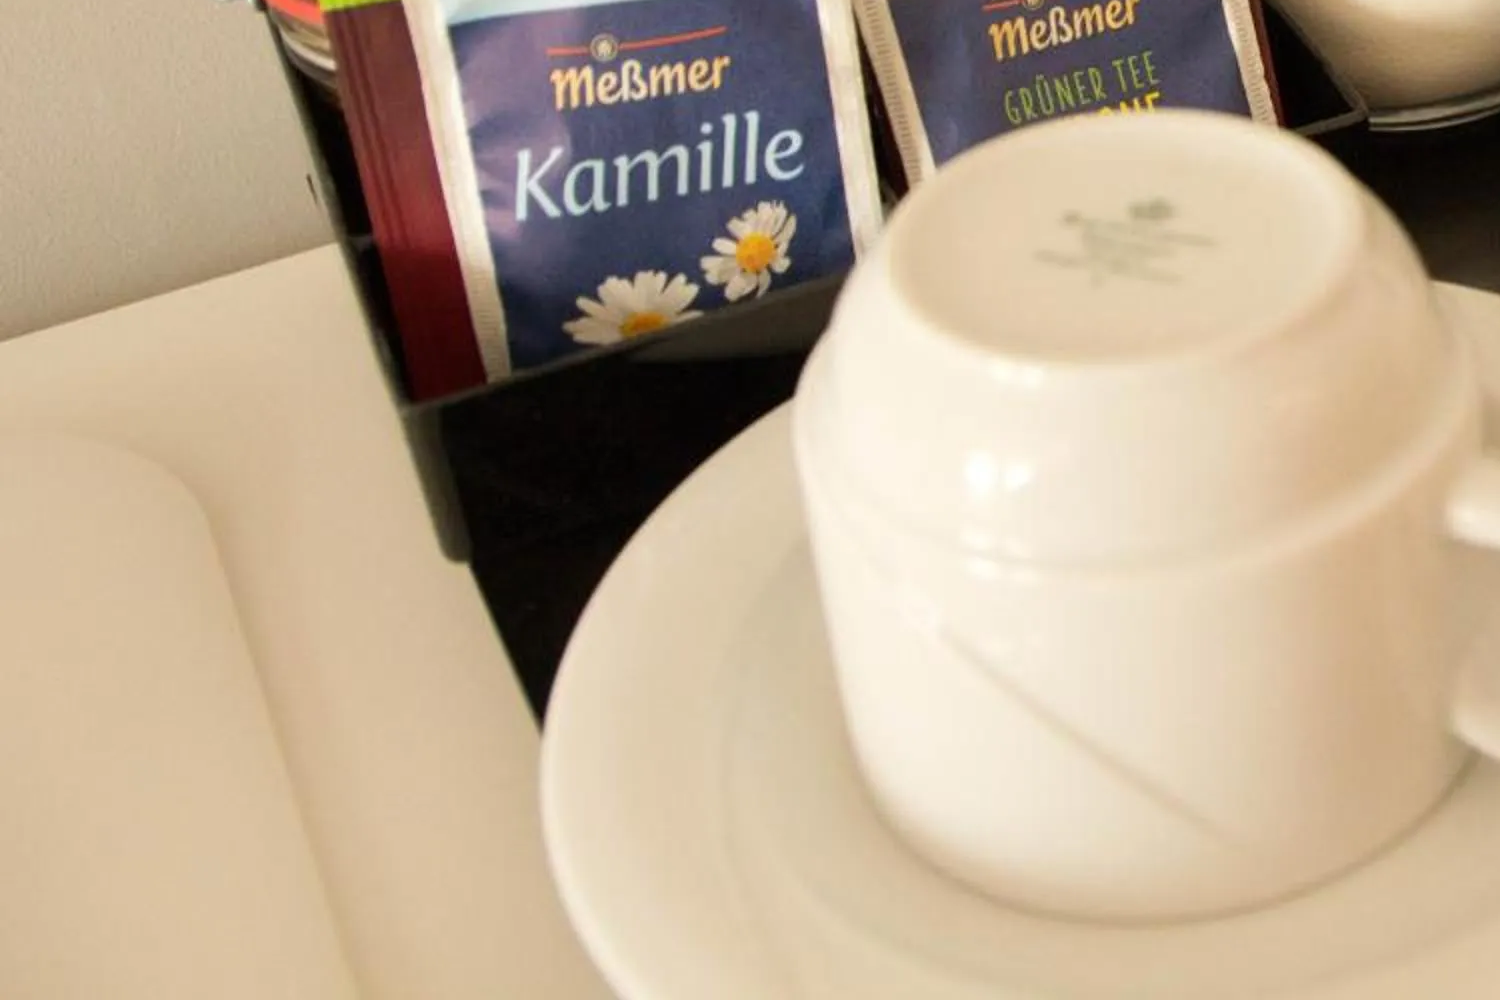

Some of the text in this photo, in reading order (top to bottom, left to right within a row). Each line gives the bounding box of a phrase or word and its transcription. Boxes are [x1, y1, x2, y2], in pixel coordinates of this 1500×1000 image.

[549, 52, 731, 110] Meßmer
[1004, 68, 1106, 126] GRÜNER
[1111, 49, 1160, 93] TEE
[515, 109, 804, 222] Kamille
